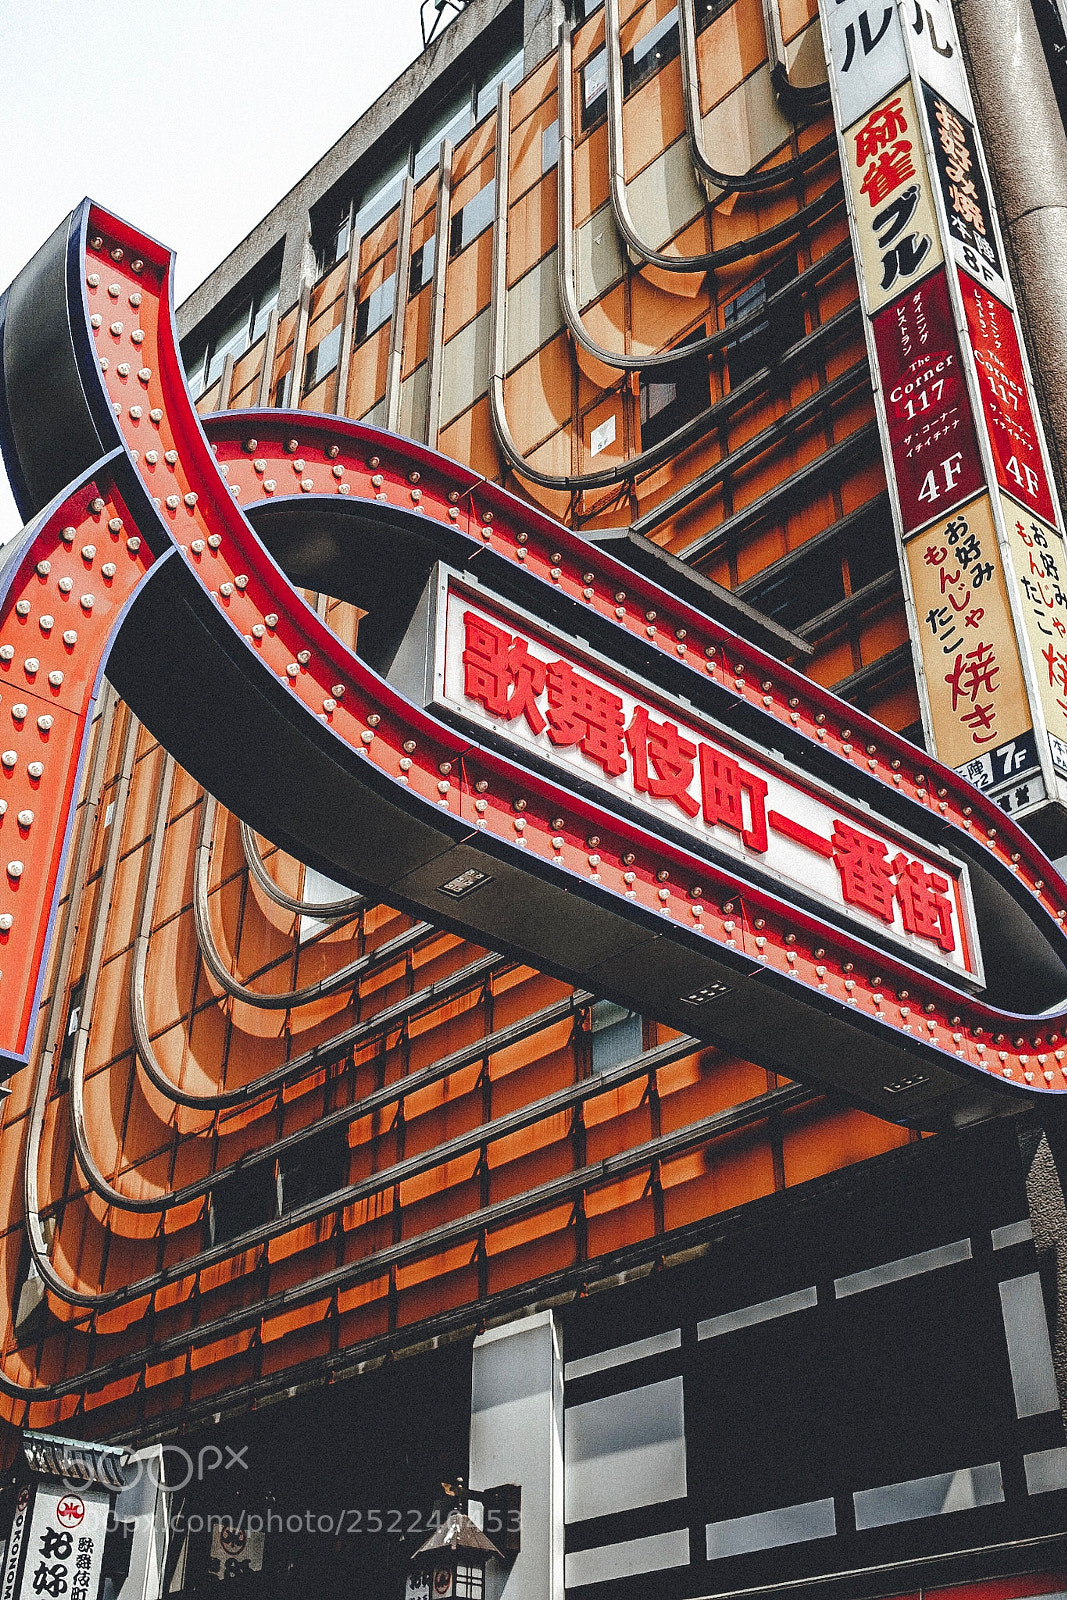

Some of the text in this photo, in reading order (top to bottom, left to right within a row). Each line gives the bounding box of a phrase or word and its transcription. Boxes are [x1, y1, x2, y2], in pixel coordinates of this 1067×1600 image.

[836, 0, 893, 72] ル
[854, 97, 932, 291] 麻雀ブル
[963, 246, 994, 282] 8F
[896, 307, 912, 356] レストラン
[913, 292, 929, 344] ダイニング
[890, 355, 953, 402] Corner
[909, 355, 931, 372] The
[974, 350, 1023, 395] Corner
[904, 379, 945, 420] 117
[988, 376, 1018, 411] 117
[918, 451, 963, 503] 4F
[1006, 455, 1039, 499] 4F
[944, 516, 995, 588] お好み
[924, 545, 985, 629] もんじゃ
[1015, 520, 1066, 638] もんじゃ
[462, 609, 957, 955] 歌舞伎町一番街
[996, 741, 1027, 775] 7F
